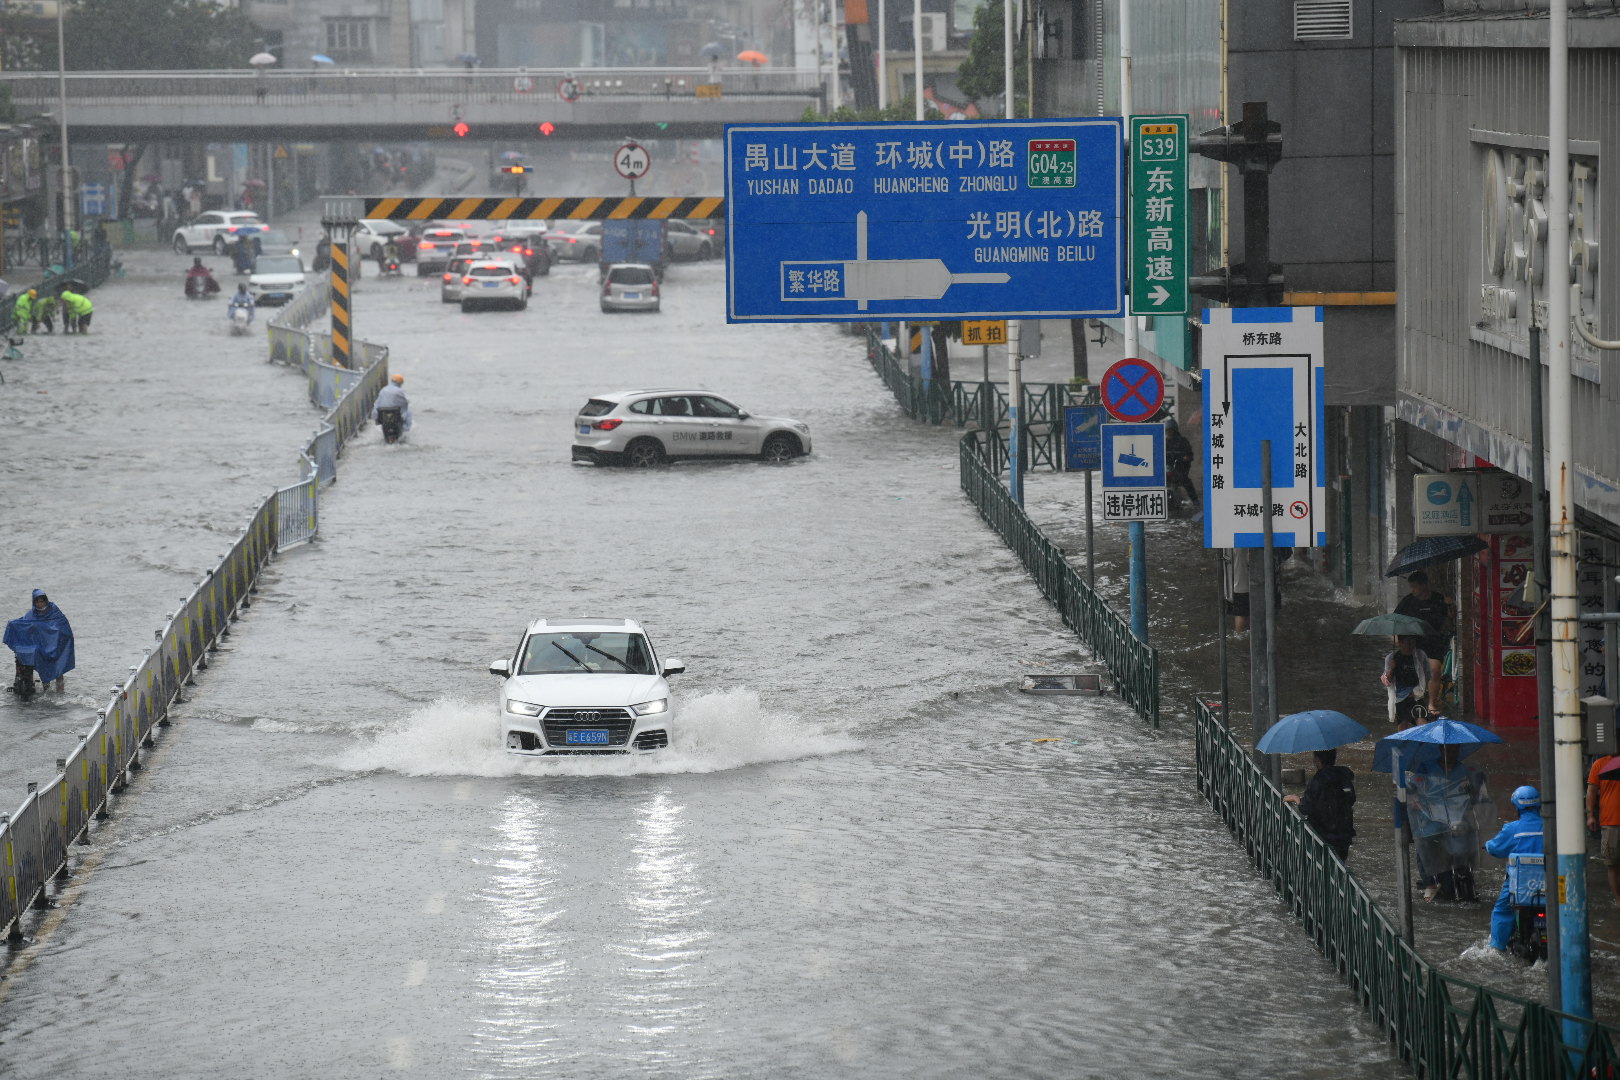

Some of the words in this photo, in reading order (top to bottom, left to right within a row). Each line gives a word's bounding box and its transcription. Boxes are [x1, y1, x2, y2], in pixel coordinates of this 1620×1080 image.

[744, 142, 857, 172] 禺山大道
[875, 139, 1015, 170] 环城(中)路
[1143, 137, 1174, 156] S39
[620, 154, 643, 169] 4m
[747, 178, 799, 196] YUSHAN
[808, 178, 854, 195] DADAO
[874, 176, 949, 194] HUANCHENG
[959, 175, 1018, 193] ZHONGLU
[1030, 176, 1073, 185] 广澳高速
[966, 209, 1105, 239] 光明(北)路
[1145, 166, 1175, 282] 东新高速
[974, 246, 1049, 263] GUANGMING
[1057, 245, 1095, 262] BEILU
[788, 268, 840, 293] 繁华路
[968, 325, 1001, 341] 抓拍
[1242, 331, 1283, 346] 桥东路
[672, 431, 697, 441] BMW
[699, 430, 733, 441] 道路救援
[1211, 413, 1225, 490] 环城中路
[1294, 421, 1308, 479] 大北路
[1106, 492, 1164, 517] 违停抓拍
